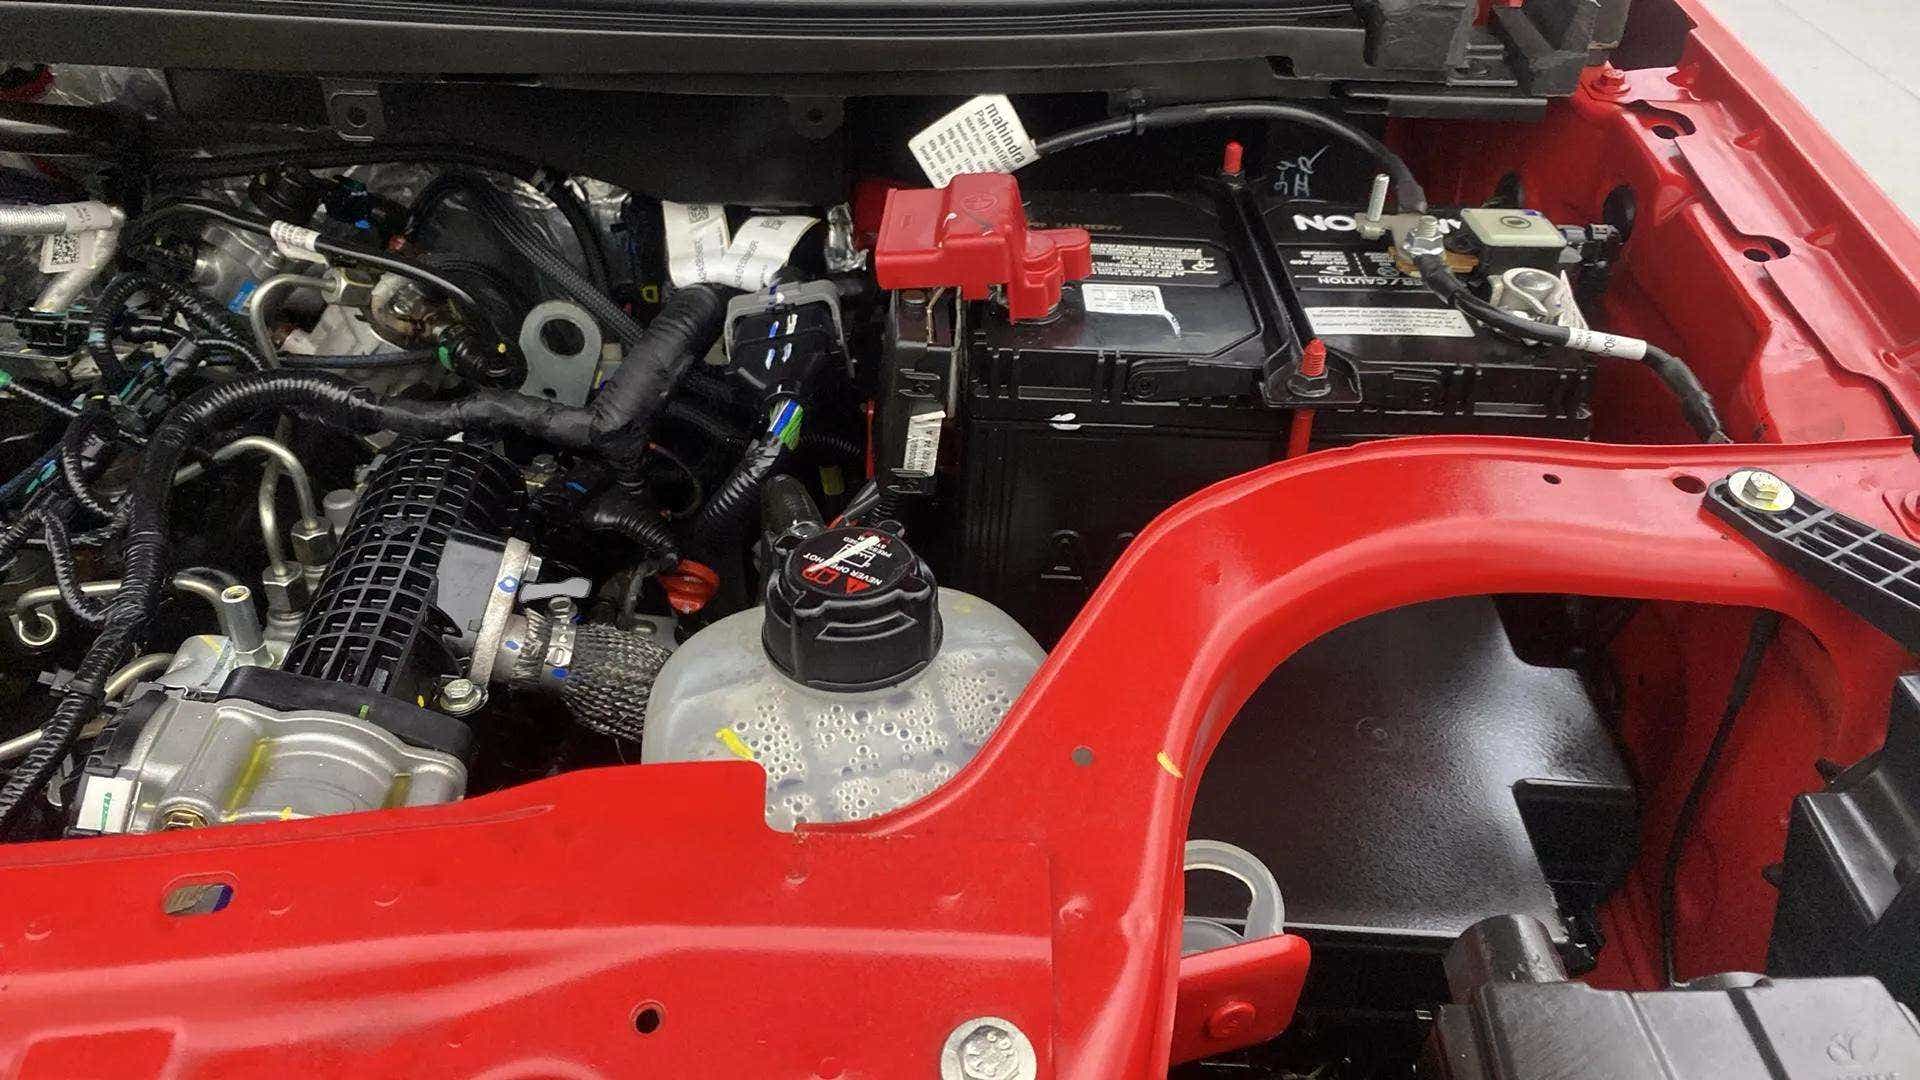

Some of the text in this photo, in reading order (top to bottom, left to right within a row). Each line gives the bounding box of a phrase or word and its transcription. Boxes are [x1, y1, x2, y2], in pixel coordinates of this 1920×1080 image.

[974, 109, 990, 130] Part
[985, 103, 1026, 164] mahindra
[1318, 277, 1388, 286] CAUTION
[849, 570, 883, 586] NEVER
